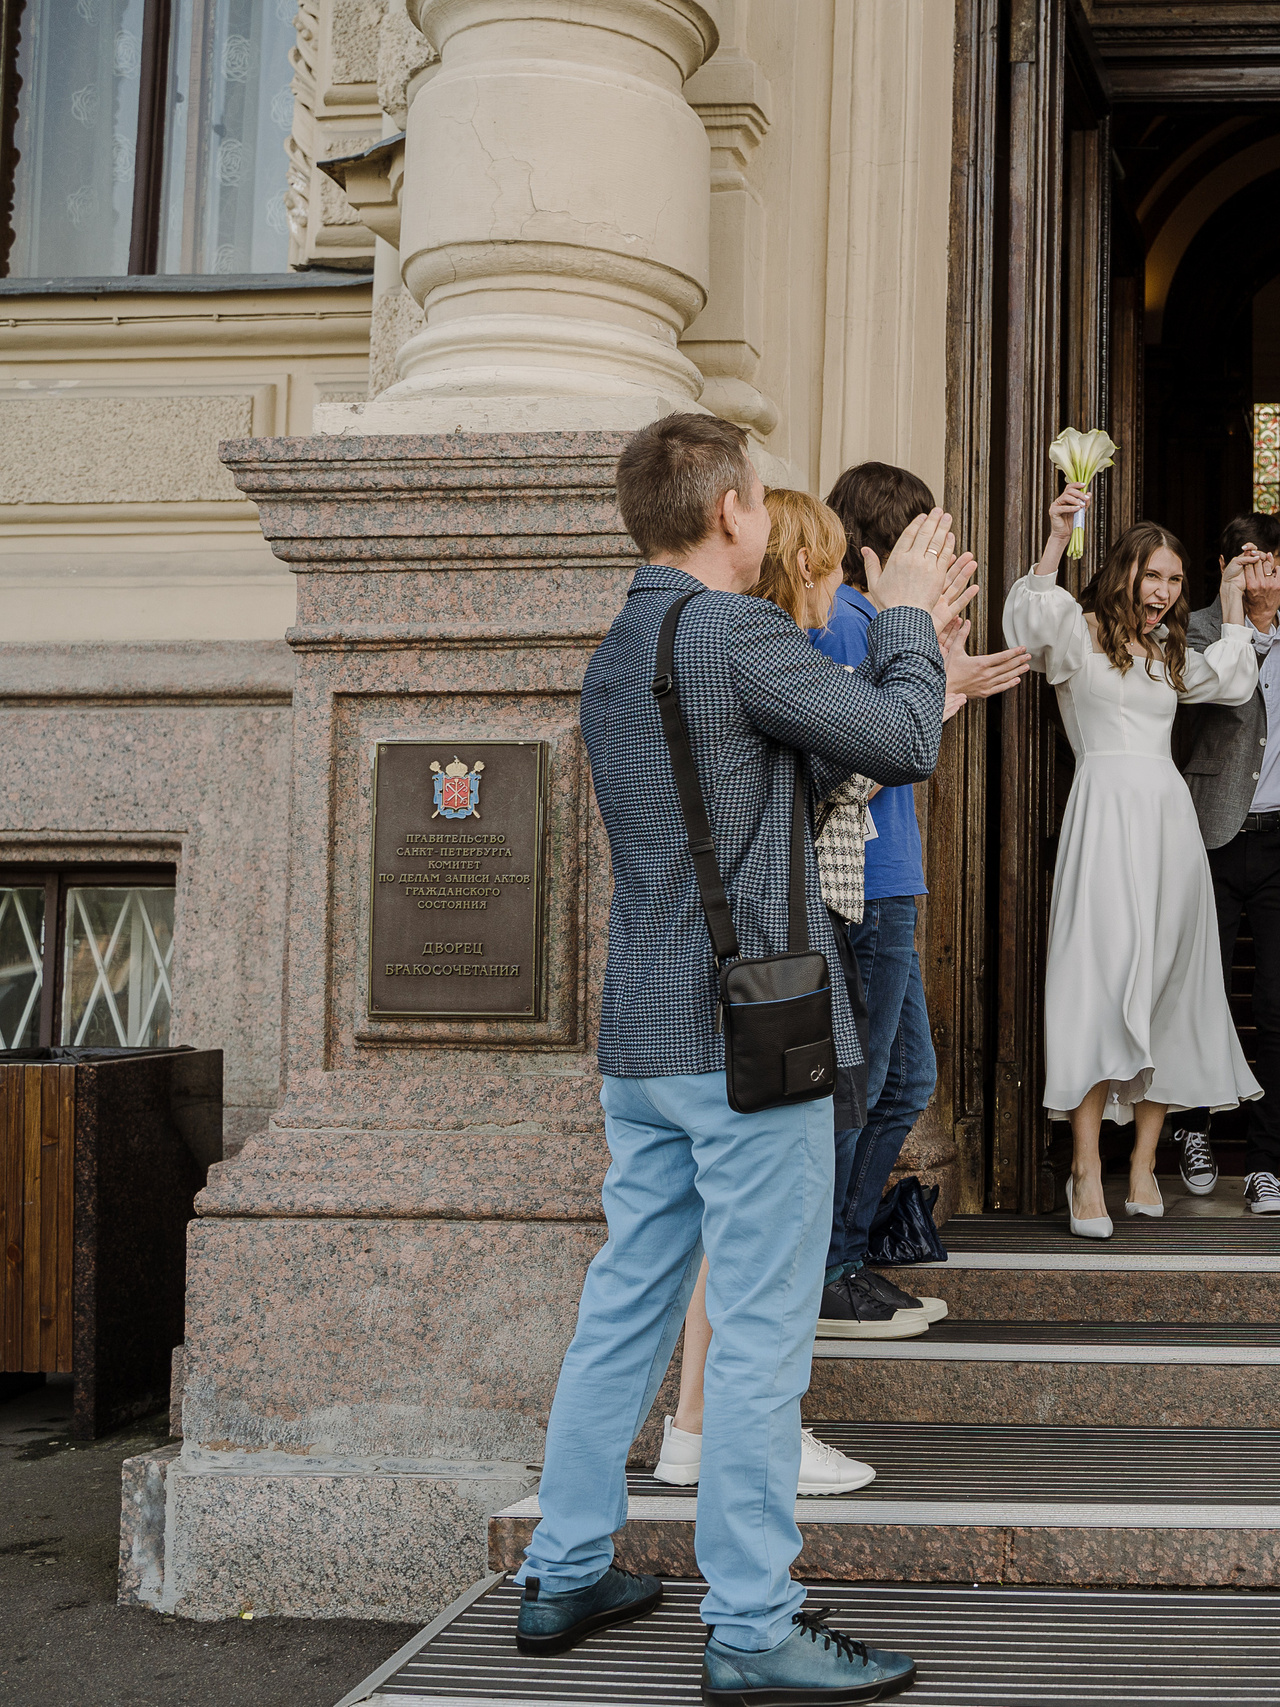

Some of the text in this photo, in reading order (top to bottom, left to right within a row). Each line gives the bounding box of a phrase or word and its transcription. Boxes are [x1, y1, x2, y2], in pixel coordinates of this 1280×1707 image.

[406, 834, 505, 844] ПРАВИТЕЛЬСТВО
[428, 861, 481, 870] КОМИТЕТ
[378, 874, 531, 884] ПО ДЕЛАМ ЗАПИСИ АКТОВ
[405, 887, 501, 897] ГРАЖДАНСКОГО
[418, 900, 487, 909] СОСТОЯНИЯ
[422, 942, 483, 956] ДВОРЕЦ
[385, 964, 520, 976] БРАКОСОЧЕТАНИЯ
